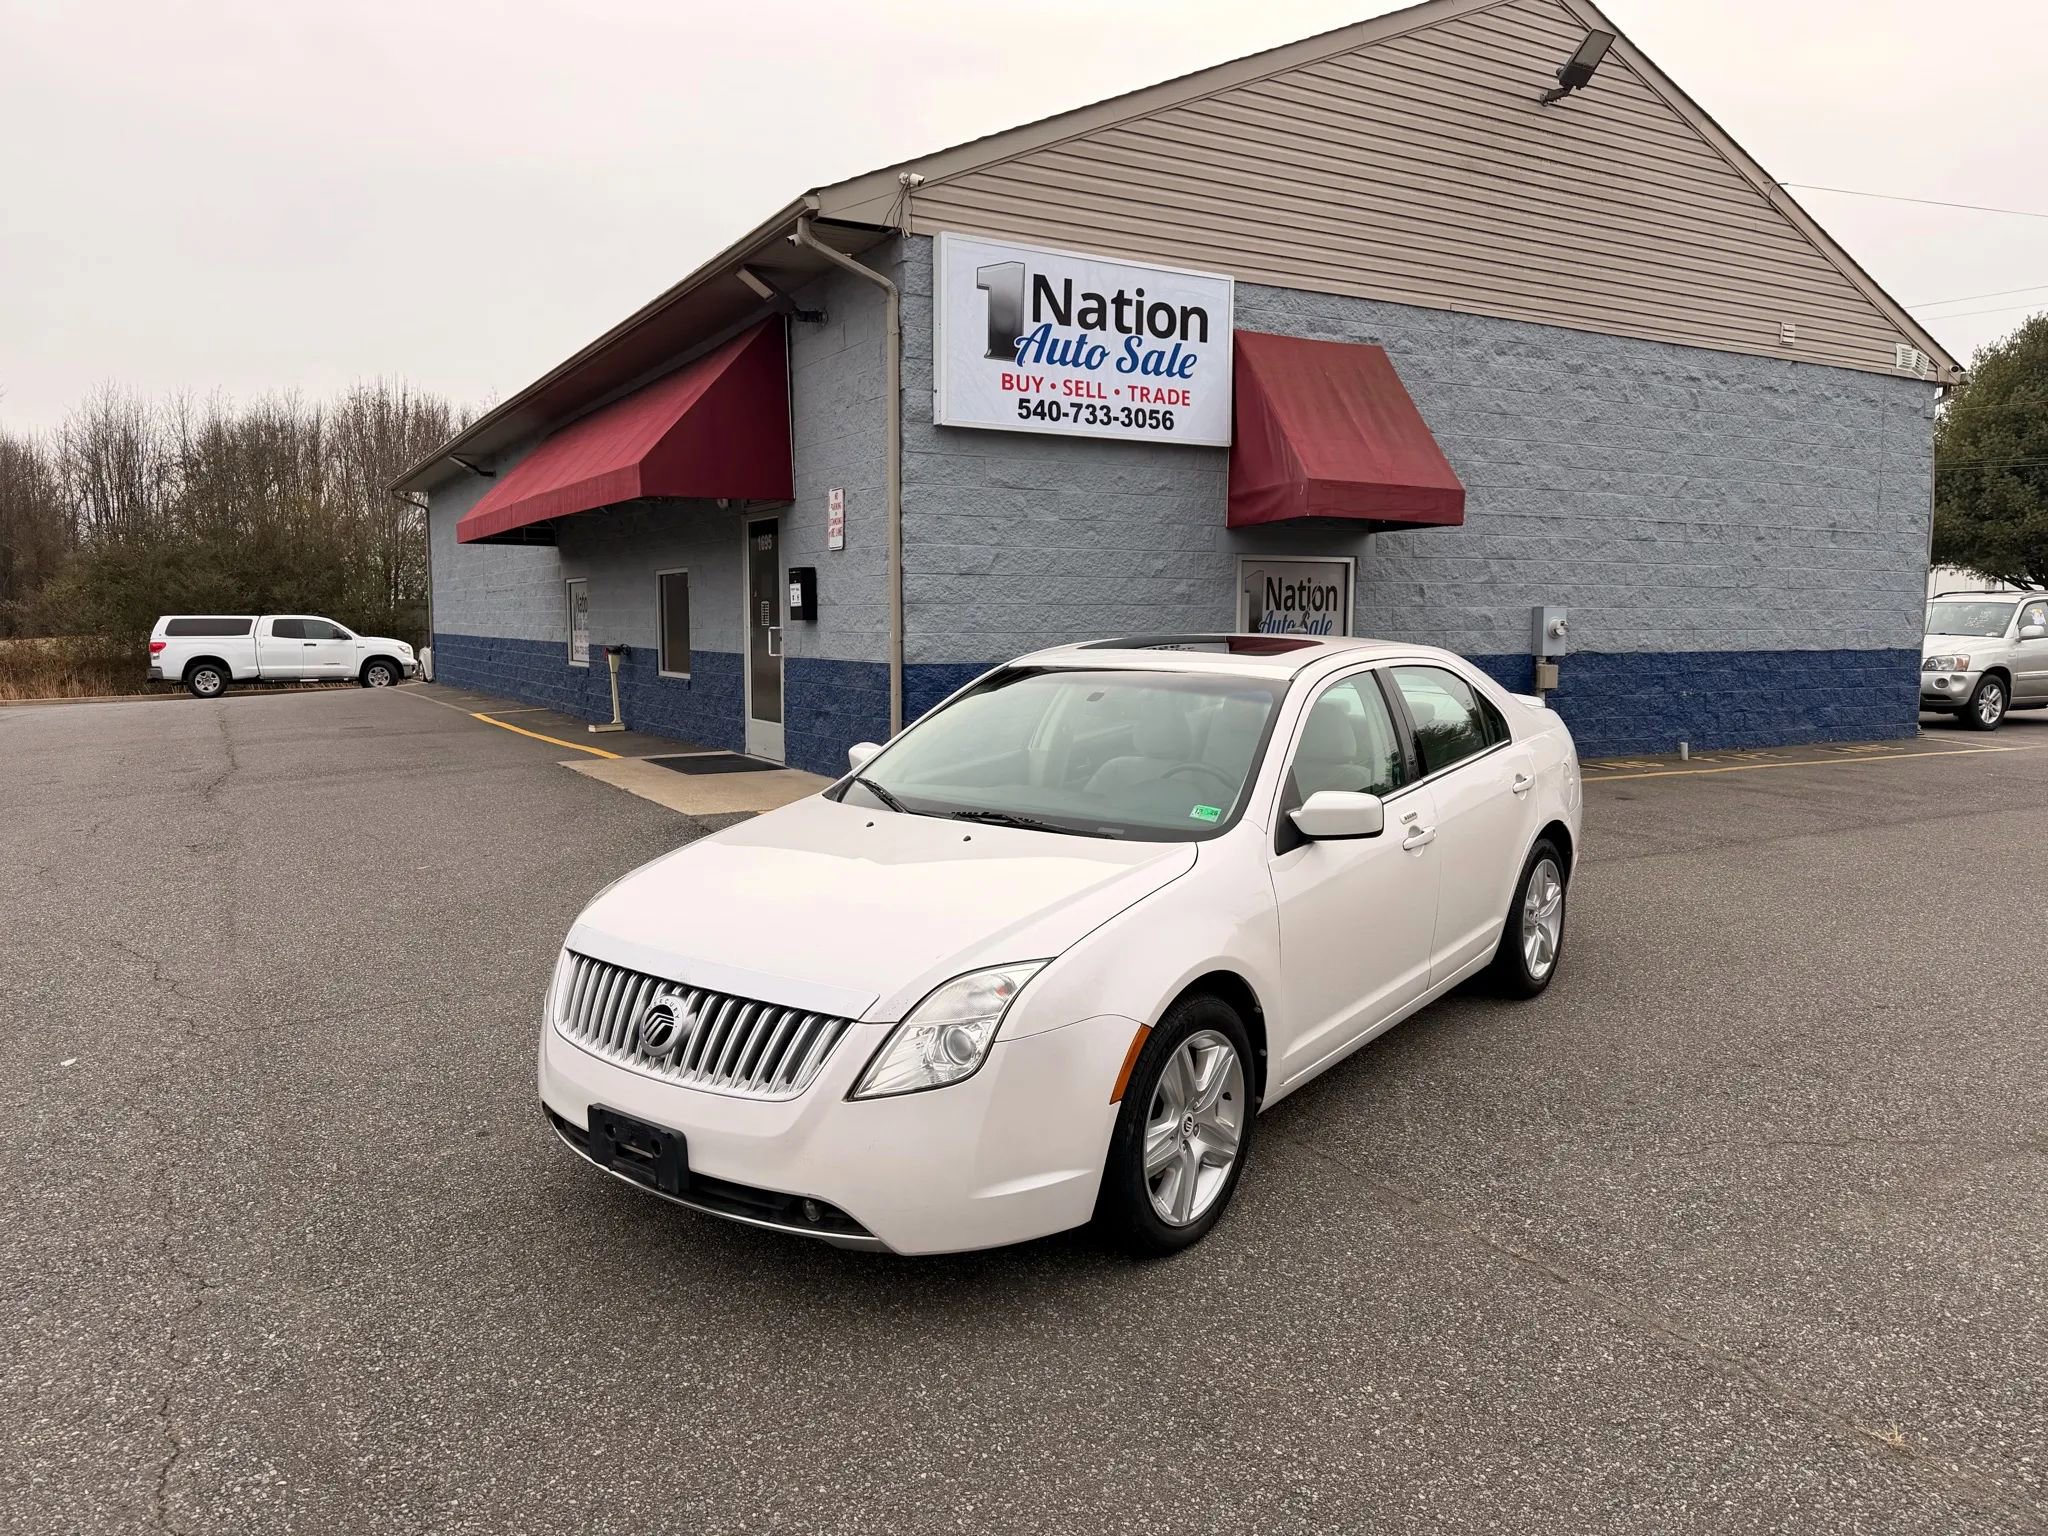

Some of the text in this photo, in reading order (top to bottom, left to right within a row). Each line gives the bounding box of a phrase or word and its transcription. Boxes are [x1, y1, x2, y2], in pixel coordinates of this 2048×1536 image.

[977, 261, 1209, 362] 1 Nation
[1014, 323, 1198, 379] Auto Sale
[1001, 373, 1191, 407] BUY SELL TRADE
[1017, 398, 1175, 431] 540-733-3056
[1265, 576, 1338, 612] Nation
